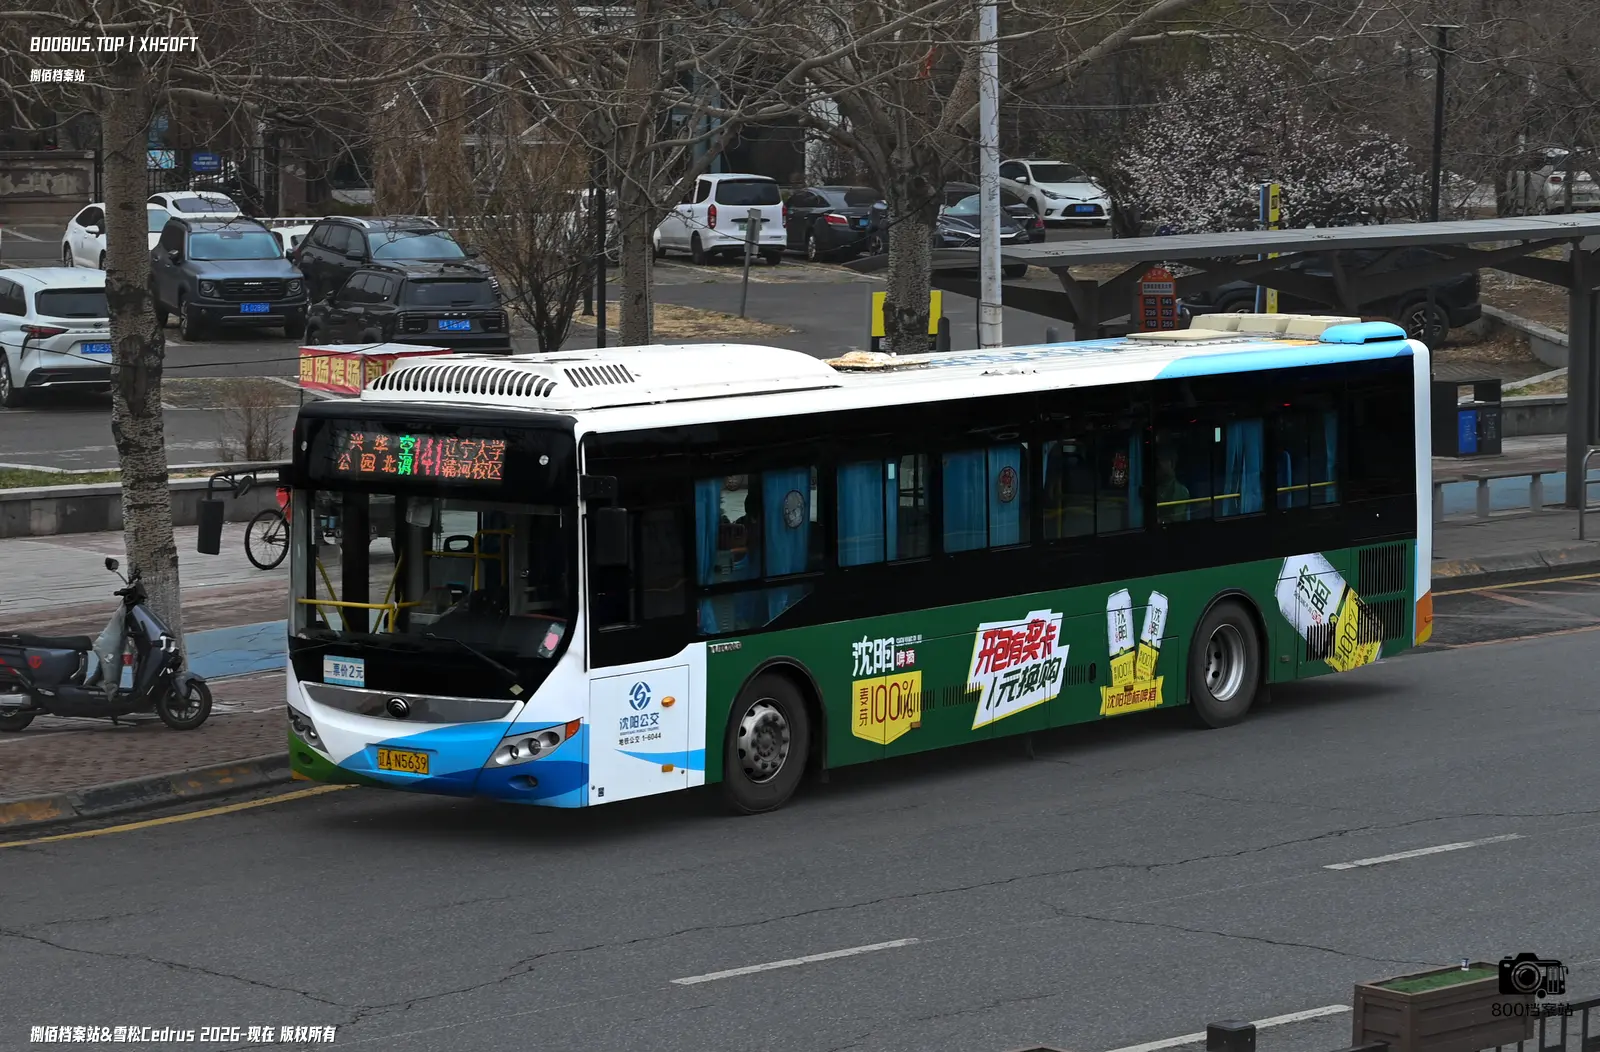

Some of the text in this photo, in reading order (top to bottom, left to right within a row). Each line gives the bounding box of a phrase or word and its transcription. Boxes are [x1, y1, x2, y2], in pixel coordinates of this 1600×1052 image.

[300, 354, 361, 388] 煎肠烤肠
[338, 453, 397, 473] 公园北
[398, 434, 416, 476] 空调
[413, 438, 444, 476] 141
[445, 438, 505, 461] 辽宁大学
[852, 635, 895, 677] 沈阳
[619, 712, 660, 730] 沈阳公交
[859, 687, 869, 727] 麦芽
[870, 679, 914, 725] 100%
